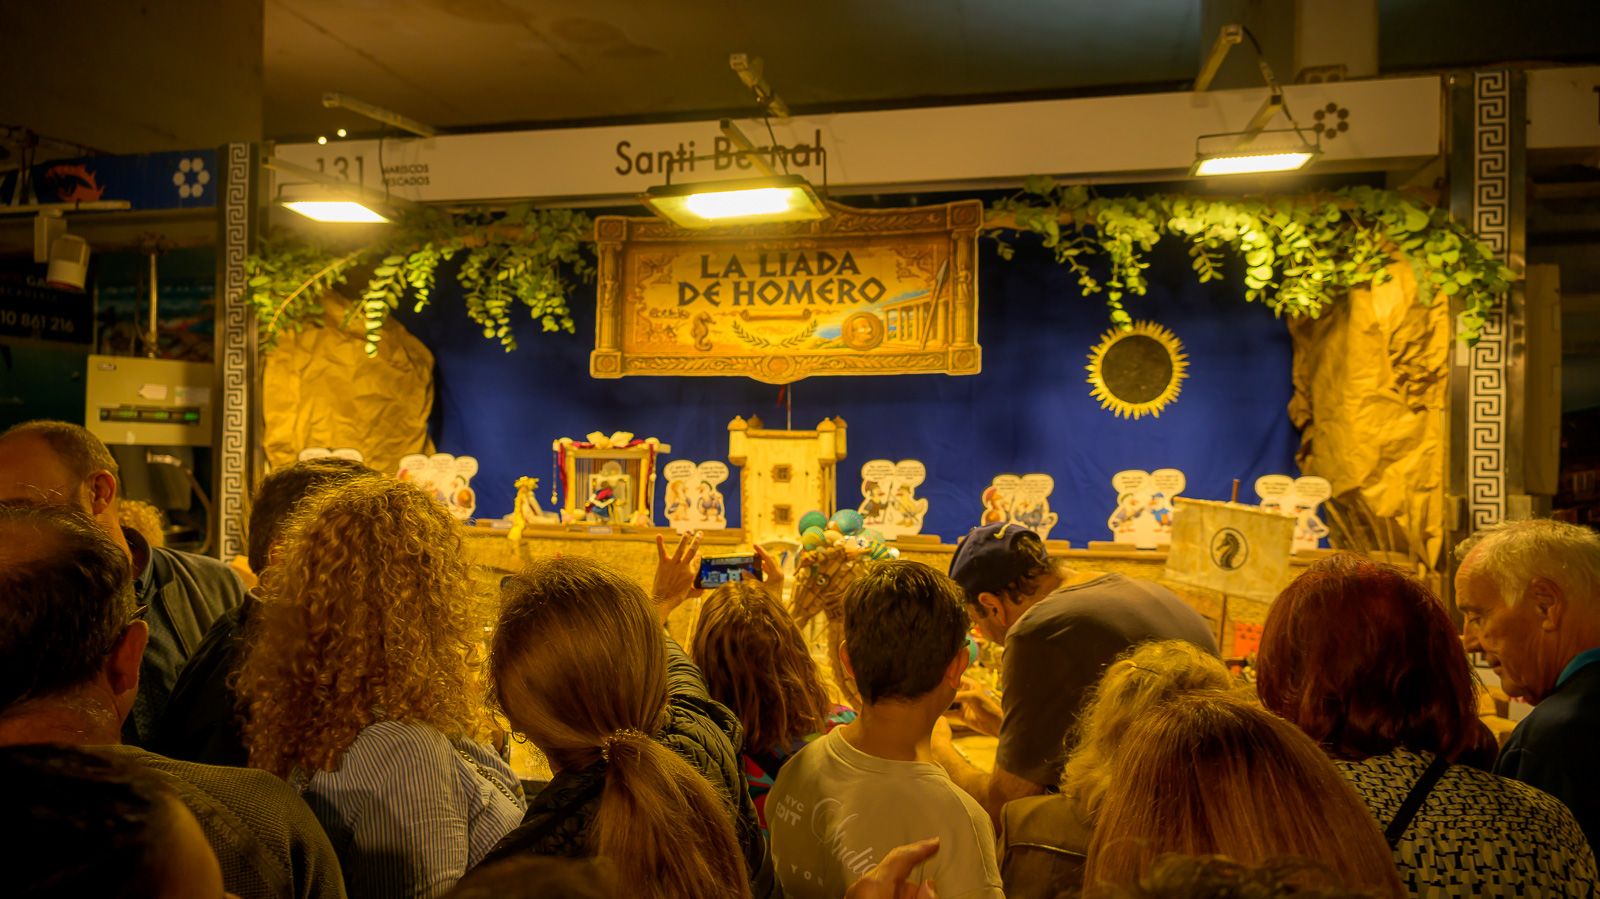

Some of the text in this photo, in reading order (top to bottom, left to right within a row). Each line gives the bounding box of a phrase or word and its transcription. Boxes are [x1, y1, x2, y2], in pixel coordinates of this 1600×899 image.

[615, 140, 695, 176] Santi
[700, 250, 862, 279] LA LIADA
[678, 276, 887, 307] DE HOMERO
